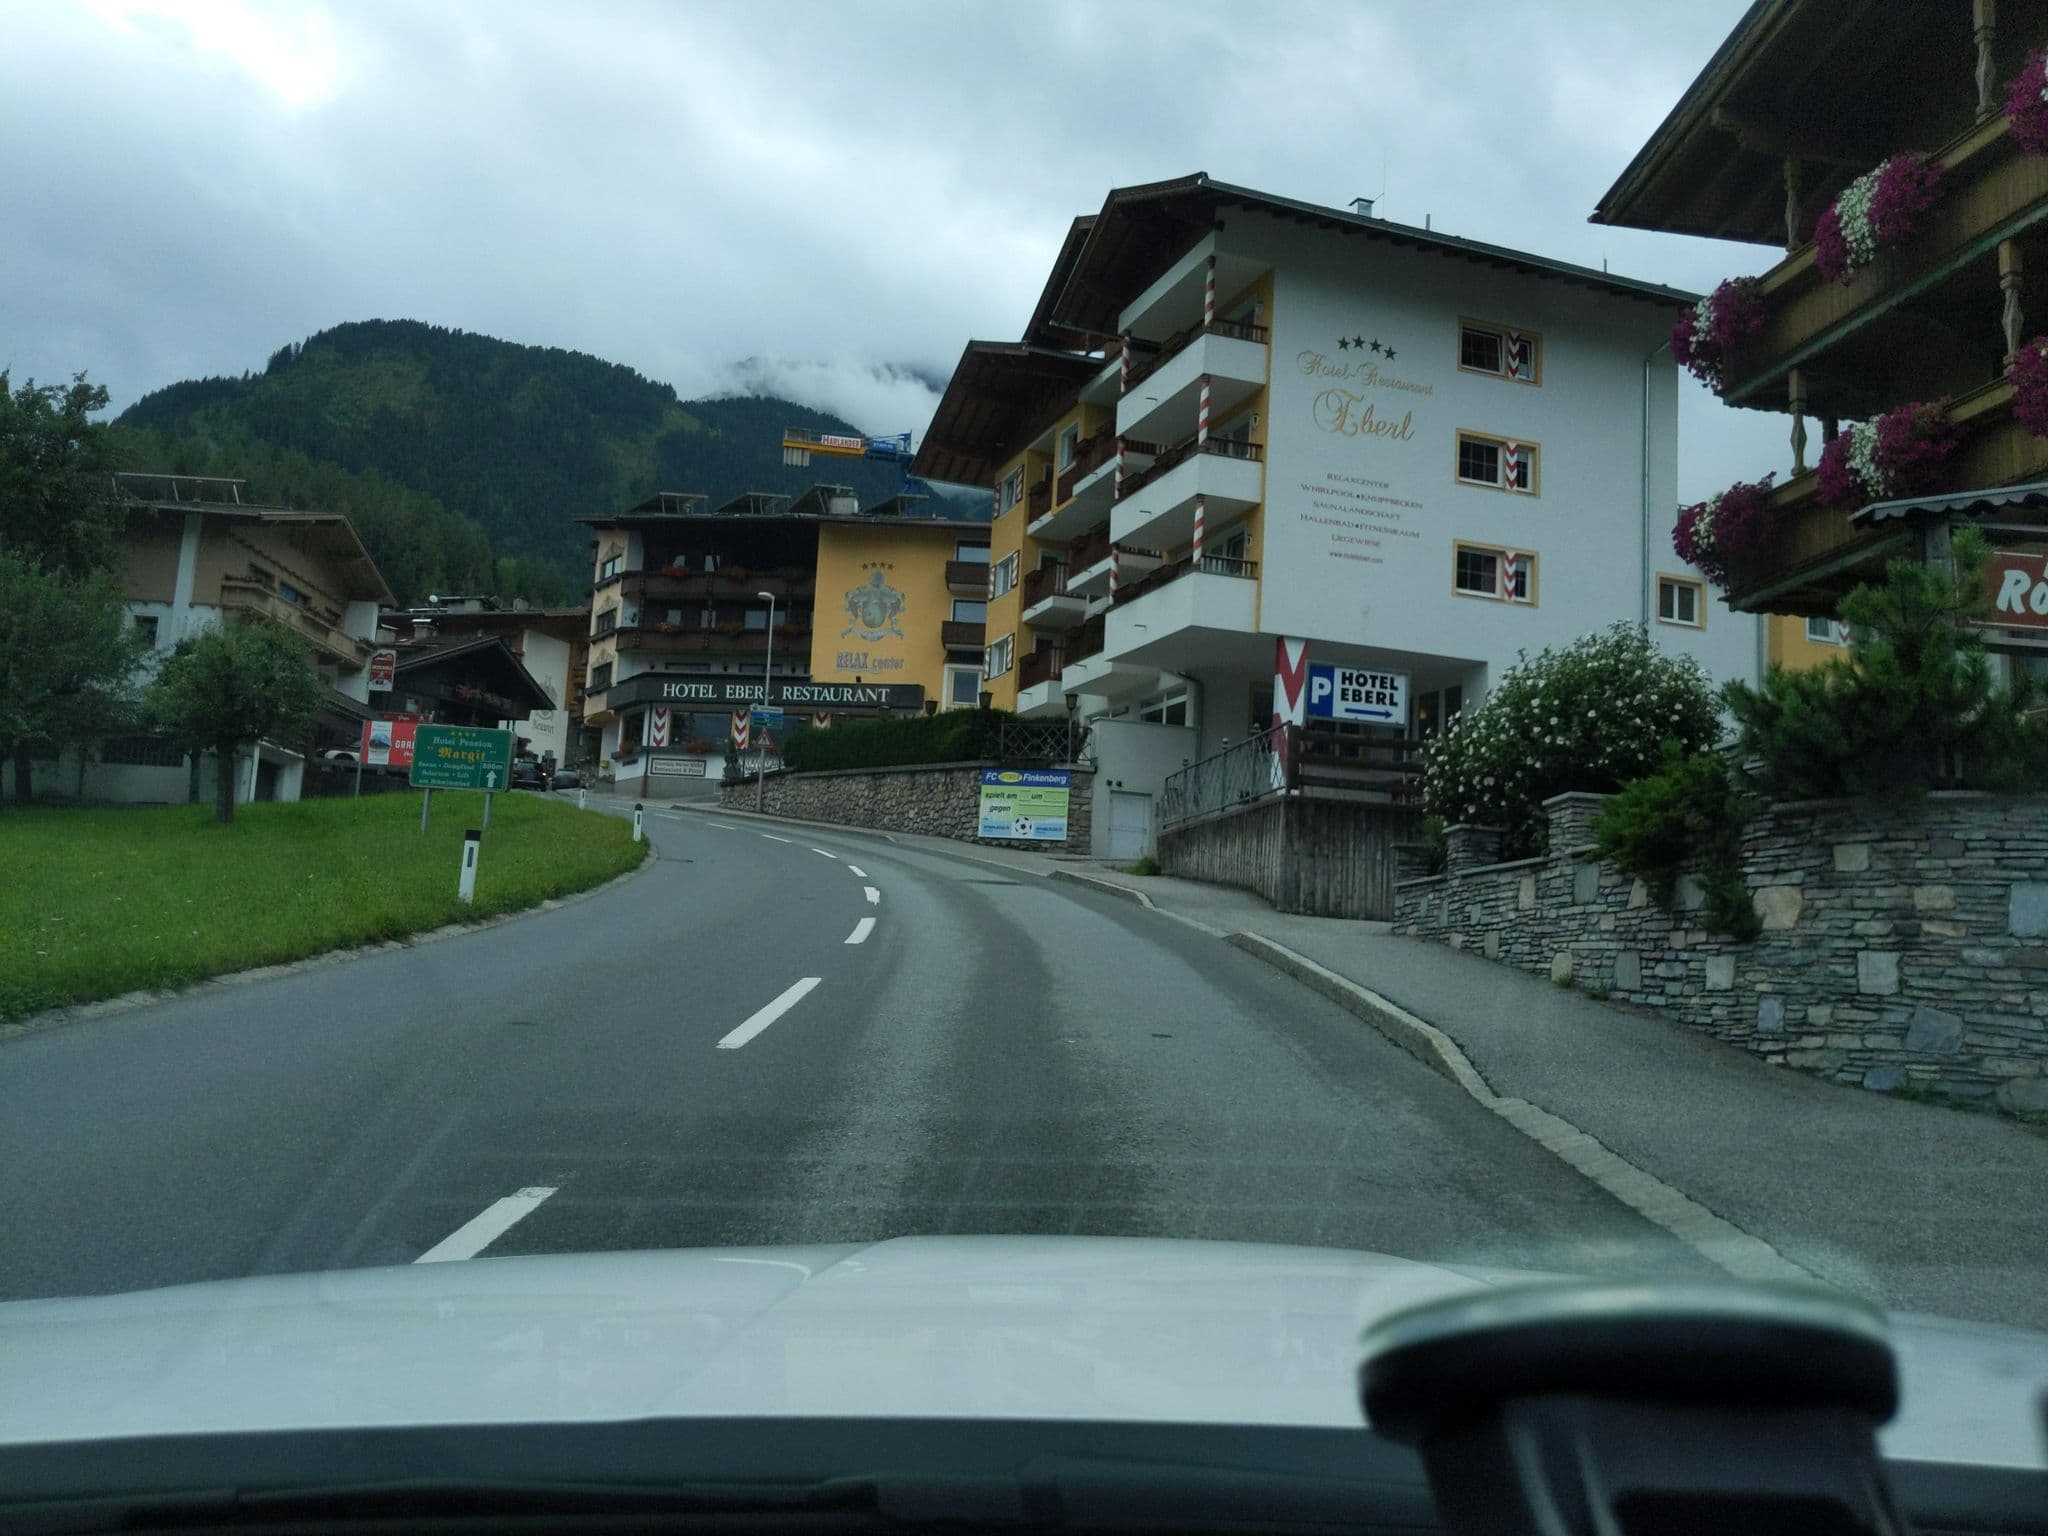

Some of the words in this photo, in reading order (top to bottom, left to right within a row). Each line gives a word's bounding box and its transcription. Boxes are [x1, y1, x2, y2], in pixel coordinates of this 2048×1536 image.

[1313, 388, 1414, 441] Eberl
[1313, 500, 1400, 520] SAUNALANDSCHAFT
[1300, 513, 1354, 528] HALLENBAD
[663, 683, 717, 698] HOTEL
[782, 686, 890, 702] RESTAURANT
[1311, 676, 1331, 704] P
[1341, 672, 1399, 691] HOTEL
[1340, 688, 1398, 706] EBERL
[433, 736, 455, 745] Hotel
[459, 739, 492, 748] Pension
[437, 746, 486, 763] Margit
[986, 772, 998, 780] FC
[1023, 773, 1067, 784] Finkenberg
[989, 805, 1011, 813] gegen
